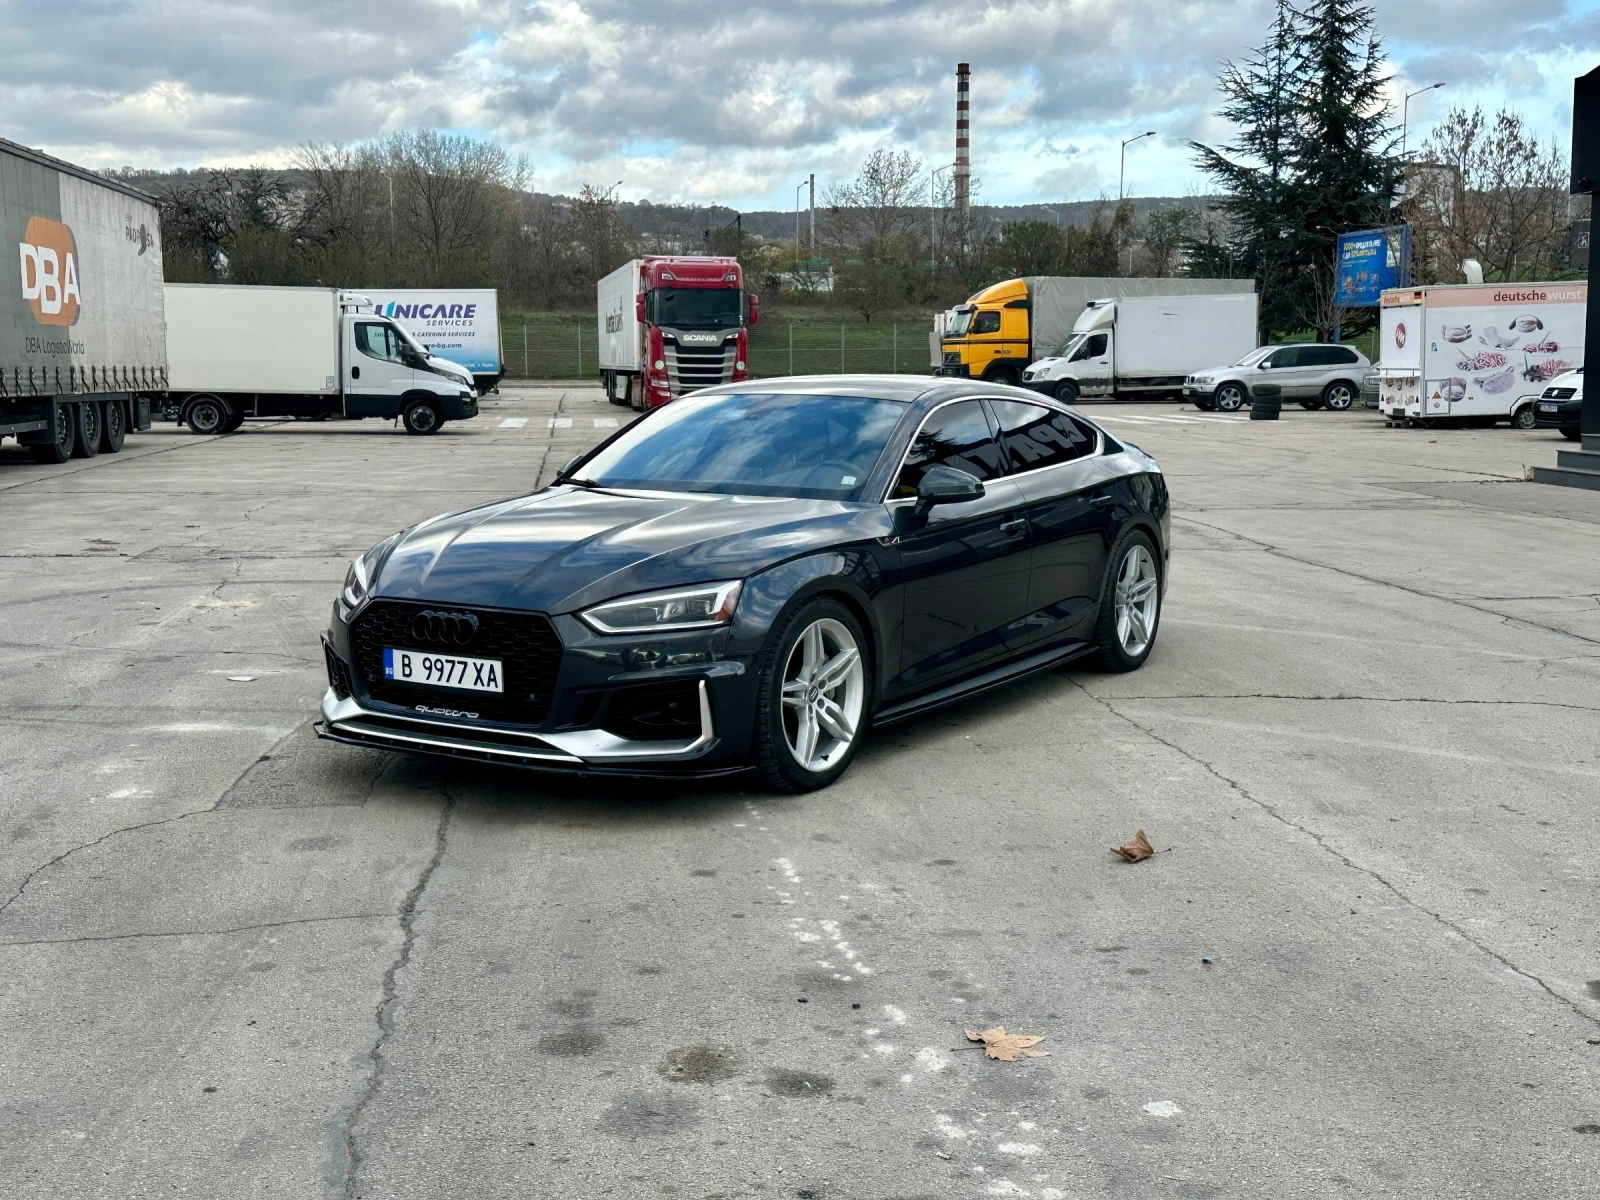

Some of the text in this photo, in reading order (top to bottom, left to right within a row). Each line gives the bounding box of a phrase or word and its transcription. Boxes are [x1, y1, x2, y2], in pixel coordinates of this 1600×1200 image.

[19, 242, 81, 314] DBA
[374, 301, 477, 319] UNICARE
[25, 337, 41, 354] DBA
[683, 334, 718, 342] SCANIA
[385, 667, 393, 675] BG
[402, 654, 499, 688] B 9977 XA
[415, 704, 479, 718] quattro
